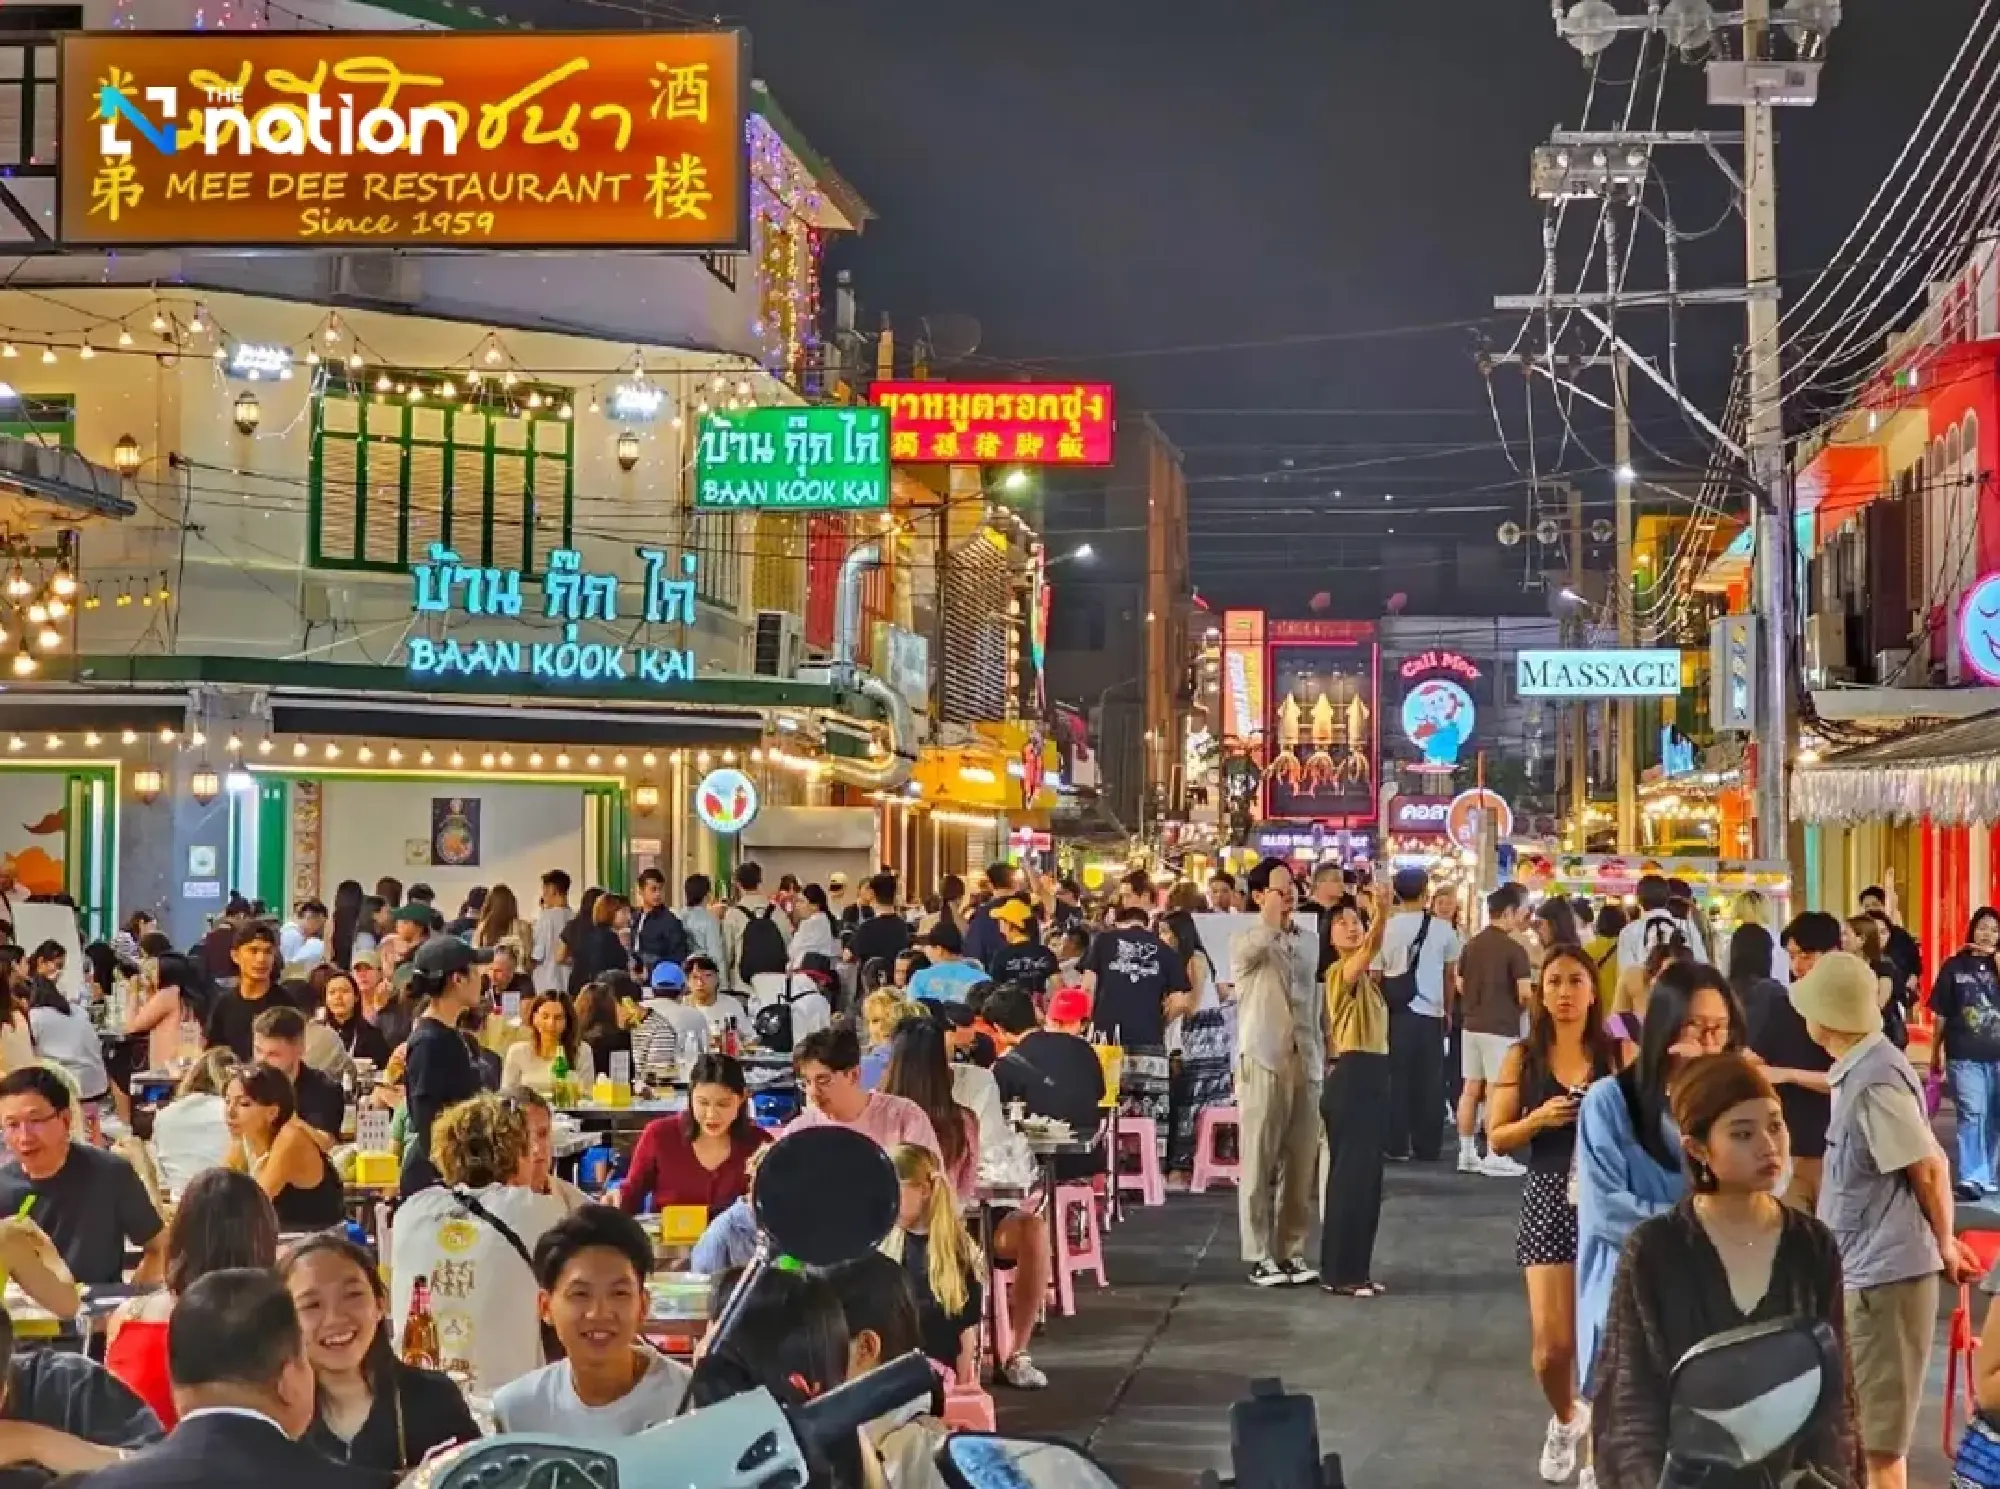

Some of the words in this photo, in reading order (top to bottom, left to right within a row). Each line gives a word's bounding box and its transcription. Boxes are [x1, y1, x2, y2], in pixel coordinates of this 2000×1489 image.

[166, 172, 252, 202] MEE
[268, 172, 348, 200] DEE
[364, 171, 632, 203] RESTAURANT
[299, 206, 399, 236] Since
[411, 210, 495, 236] 1959
[703, 412, 775, 465] บ้าน
[841, 413, 882, 465] ไก่
[703, 479, 769, 504] BAAN
[776, 480, 835, 504] KOOK
[843, 480, 879, 504] KAI
[412, 543, 522, 616] บ้าน
[546, 549, 618, 642] กุ๊ก
[638, 548, 697, 625] ไก่
[408, 637, 521, 676] BAAN
[532, 642, 627, 680] KOOK
[639, 648, 696, 683] KAI
[1520, 659, 1678, 688] MASSAGE
